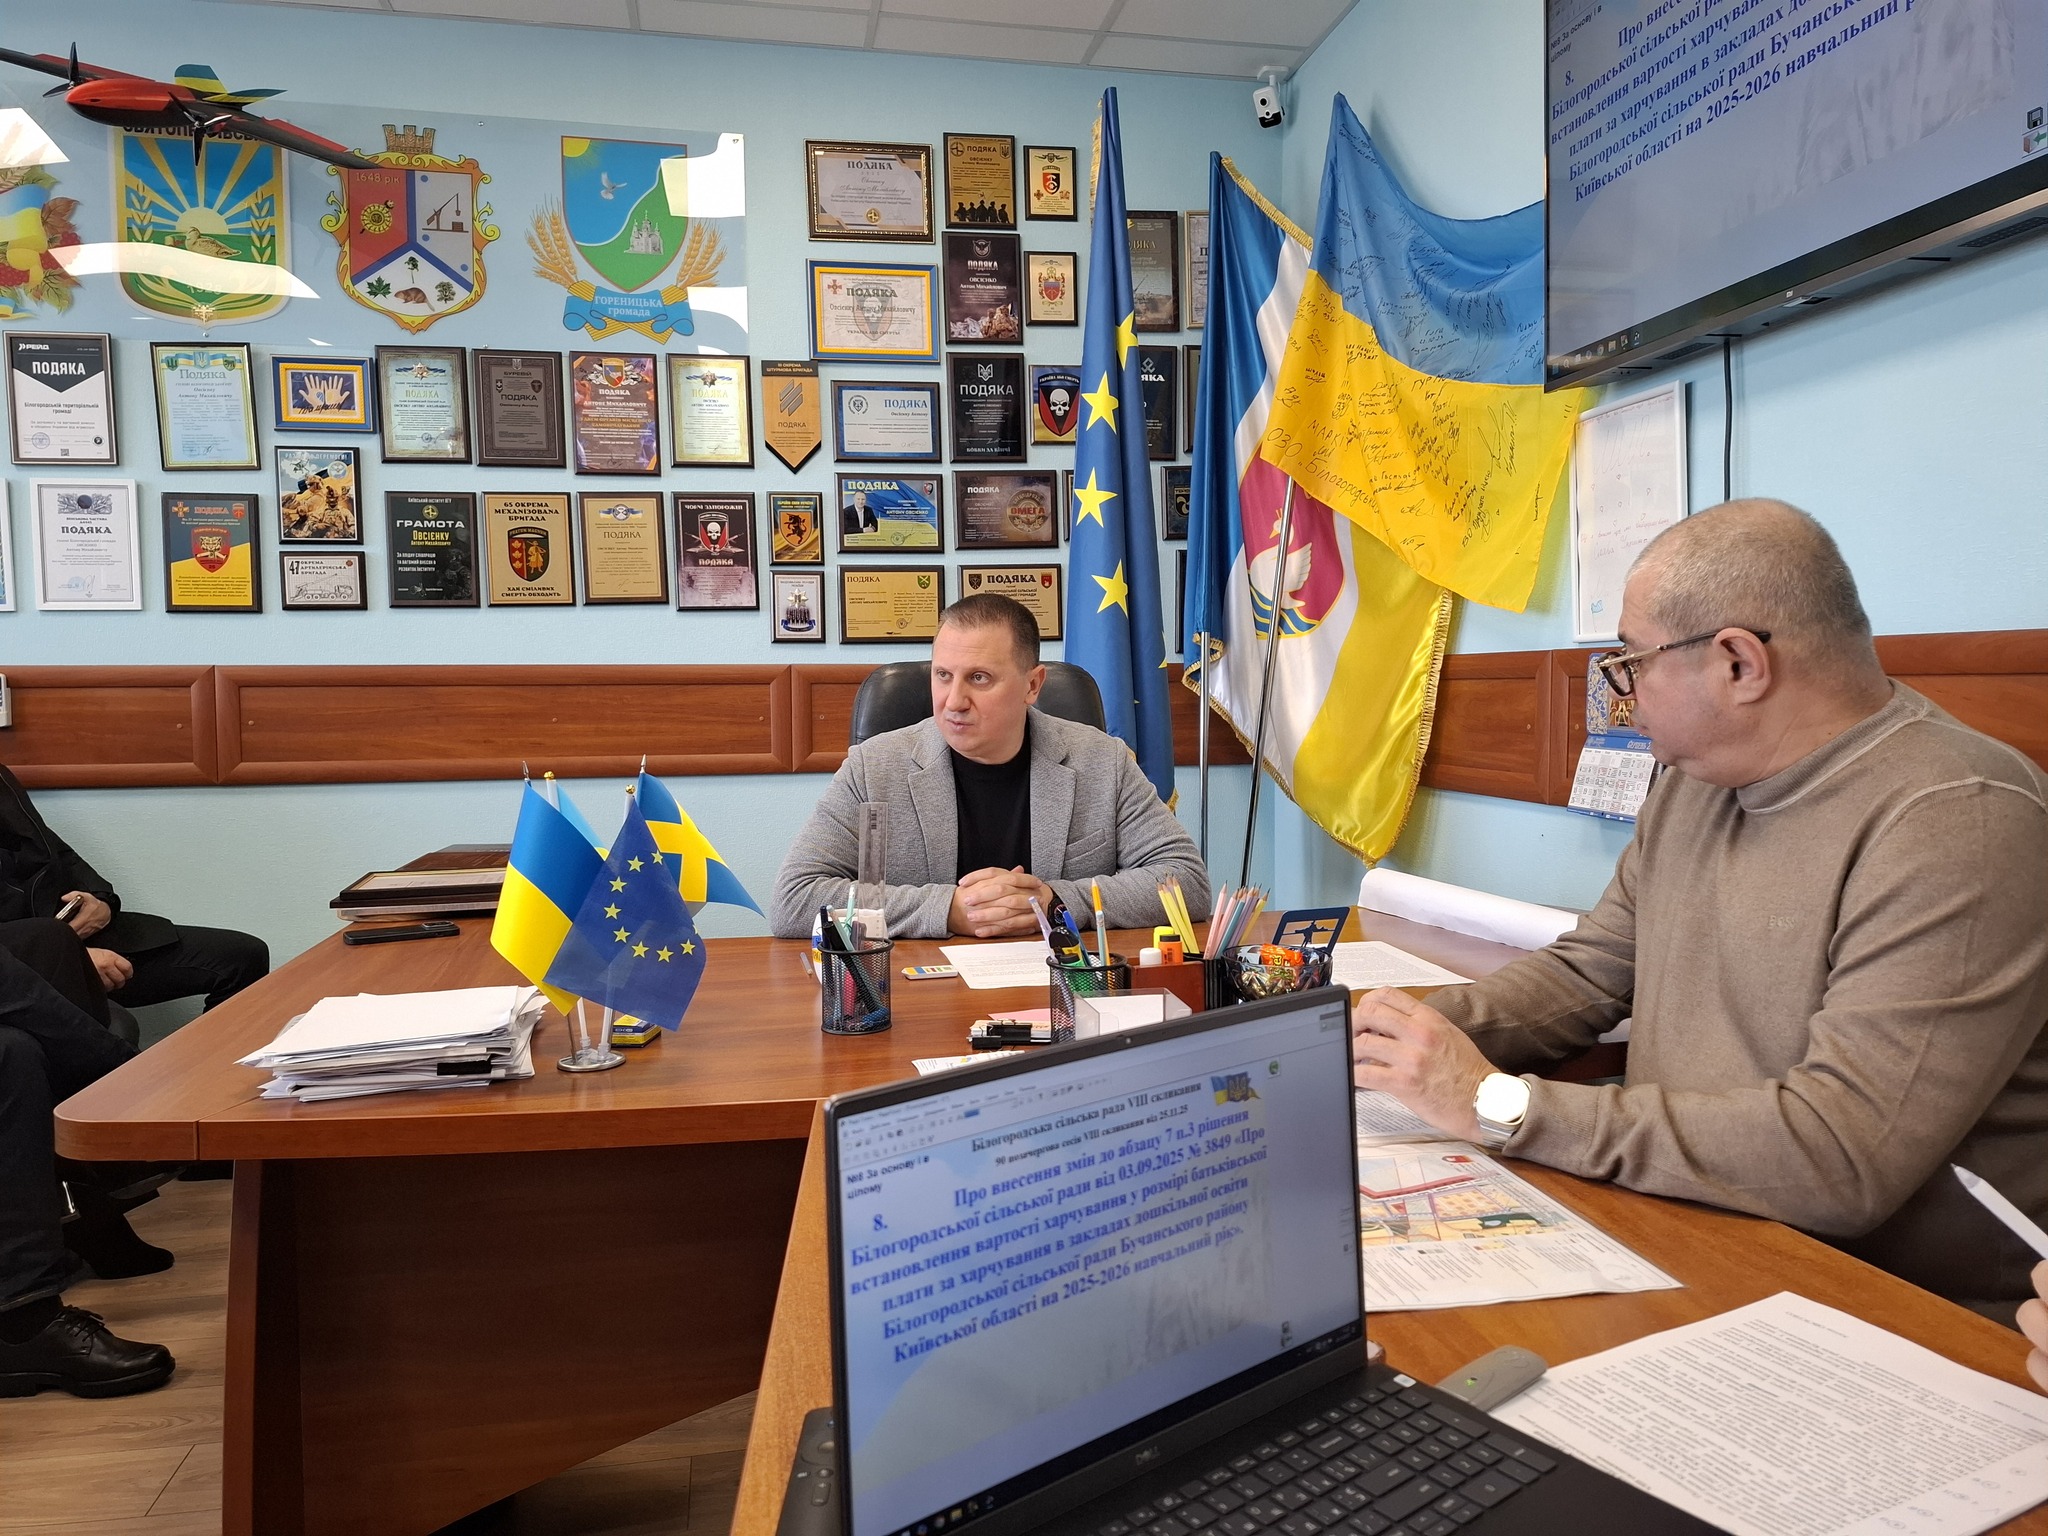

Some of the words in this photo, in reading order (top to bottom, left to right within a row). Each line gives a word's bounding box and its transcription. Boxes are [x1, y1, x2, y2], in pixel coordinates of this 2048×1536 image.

[1562, 31, 1570, 42] За
[1570, 14, 1592, 36] основу
[1618, 21, 1642, 48] Про
[1550, 41, 1572, 63] цілому
[1552, 46, 1638, 121] Білогородської
[1640, 2, 1701, 58] сільської
[1564, 70, 1574, 87] 8.
[1570, 126, 1602, 157] плати
[1606, 117, 1617, 134] за
[1621, 64, 1696, 126] харчування
[1702, 56, 1710, 71] в
[1714, 7, 1784, 63] закладах
[1551, 82, 1629, 145] встановлення
[1633, 39, 1686, 91] вартості
[1569, 111, 1658, 182] Білогородської
[1661, 69, 1724, 125] сільської
[1728, 47, 1765, 87] ради
[1575, 153, 1633, 201] Київської
[1636, 123, 1682, 166] області
[1686, 117, 1702, 138] на
[1706, 63, 1781, 125] 2025-2026
[848, 160, 893, 170] ПОДЯКА
[356, 172, 382, 184] 1648
[384, 174, 400, 186] рік
[968, 260, 998, 268] ПОДЯКА
[594, 294, 663, 308] ГОРЕНИЦЬКА
[846, 288, 898, 298] ПОДЯКА
[608, 305, 651, 318] громада
[32, 361, 86, 375] ПОДЯКА
[180, 369, 226, 379] Подяка
[406, 390, 439, 398] ПОДЯКА
[960, 384, 1014, 397] ПОДЯКА
[884, 399, 928, 409] ПОДЯКА
[848, 481, 899, 490] ПОДЯКА
[61, 526, 112, 534] ПОДЯКА
[396, 520, 465, 528] ГРАМОТА
[603, 531, 641, 540] ПОДЯКА
[290, 561, 300, 574] 47
[987, 575, 1036, 584] ПОДЯКА
[971, 1118, 1053, 1152] Білогородська
[1055, 1108, 1100, 1131] сільська
[1102, 1102, 1125, 1120] рада
[1128, 1094, 1148, 1109] VIII
[1151, 1082, 1201, 1104] скликання
[1008, 1139, 1060, 1164] позачергова
[1062, 1135, 1082, 1148] сесія
[1083, 1128, 1100, 1141] VIII
[1102, 1119, 1144, 1136] скликання
[1146, 1114, 1158, 1125] від
[1159, 1104, 1188, 1121] 25.11.25
[954, 1186, 988, 1208] Про
[992, 1166, 1062, 1196] внесення
[1066, 1152, 1096, 1174] змін
[1099, 1150, 1116, 1165] до
[1118, 1136, 1162, 1158] абзацу
[1166, 1128, 1173, 1143] 7
[1176, 1122, 1195, 1140] п.3
[1198, 1110, 1250, 1138] рішення
[866, 1167, 878, 1180] За
[881, 1158, 915, 1178] основу
[848, 1182, 882, 1200] цілому
[851, 1210, 981, 1267] Білогородської
[983, 1188, 1053, 1224] сільської
[1057, 1178, 1092, 1205] ради
[1095, 1171, 1116, 1188] від
[1118, 1148, 1184, 1180] 03.09.2025
[1187, 1144, 1202, 1158] №
[1204, 1134, 1232, 1154] 3849
[1234, 1126, 1266, 1146] «Про
[850, 1244, 972, 1296] встановлення
[976, 1216, 1040, 1254] вартості
[1044, 1194, 1128, 1231] харчування
[1131, 1190, 1138, 1206] у
[1142, 1171, 1188, 1203] розмірі
[1192, 1146, 1268, 1182] батьківської
[873, 1214, 888, 1232] 8.
[882, 1284, 934, 1312] плати
[940, 1276, 955, 1292] за
[960, 1242, 1052, 1284] харчування
[1056, 1239, 1064, 1252] в
[1068, 1217, 1131, 1248] закладах
[1134, 1187, 1209, 1225] дошкільної
[1211, 1176, 1249, 1198] освіти
[884, 1278, 1010, 1340] Білогородської
[1012, 1254, 1080, 1292] сільської
[1084, 1246, 1116, 1270] ради
[1120, 1215, 1204, 1254] Бучанського
[1206, 1200, 1250, 1226] району
[894, 1317, 978, 1363] Київської
[981, 1294, 1038, 1330] області
[1041, 1291, 1059, 1309] на
[1063, 1262, 1131, 1300] 2025-2026
[1134, 1232, 1212, 1274] навчальний
[1215, 1225, 1244, 1246] рік».
